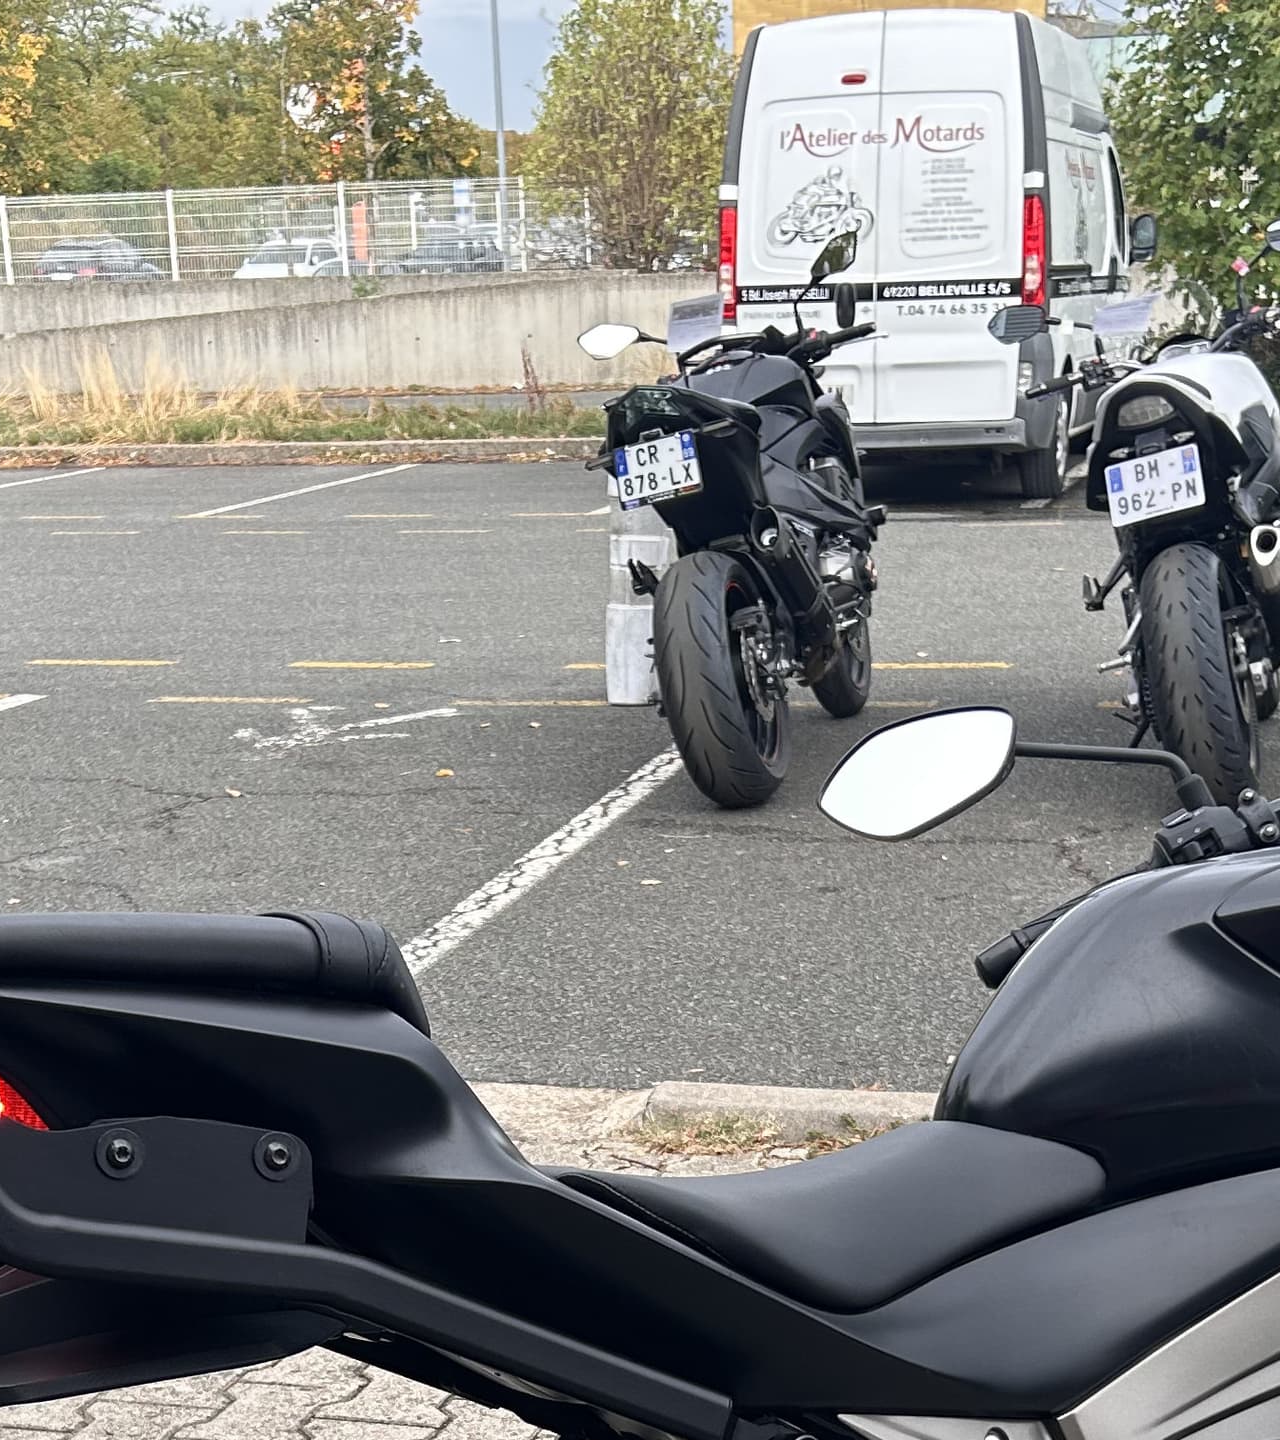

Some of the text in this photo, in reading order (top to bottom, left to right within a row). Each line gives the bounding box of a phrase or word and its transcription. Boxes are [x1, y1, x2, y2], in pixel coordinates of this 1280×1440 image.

[780, 116, 985, 157] l'Atelier des Motards
[918, 284, 986, 296] BELLEVILLE
[987, 282, 1011, 295] S/S
[929, 305, 945, 315] 74
[949, 304, 966, 315] 66
[971, 303, 987, 314] 35
[636, 444, 659, 466] CR
[623, 463, 694, 496] 878-LX
[1118, 477, 1197, 515] 962-PN
